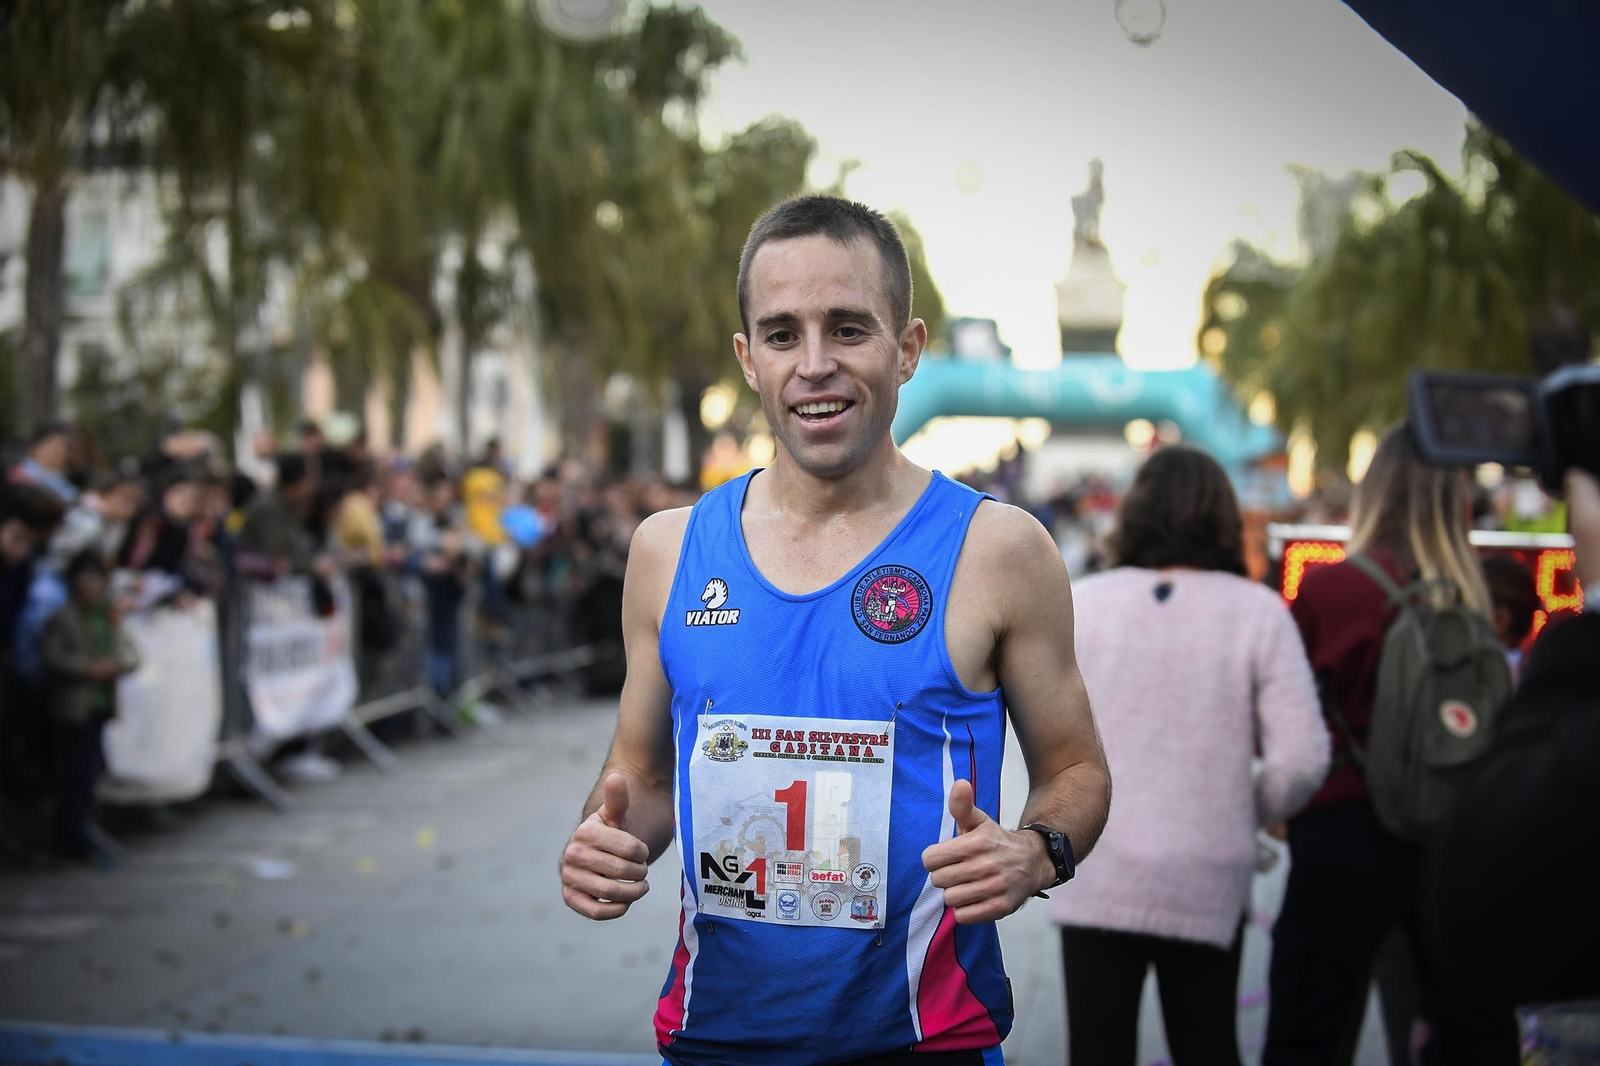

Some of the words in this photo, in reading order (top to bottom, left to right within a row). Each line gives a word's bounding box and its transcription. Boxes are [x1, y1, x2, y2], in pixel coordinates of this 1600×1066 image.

[865, 567, 906, 584] ATLETISMO
[856, 584, 866, 594] DE
[907, 572, 929, 604] CARMONA
[855, 597, 863, 618] CLUB
[916, 605, 929, 627] PAEZ
[686, 608, 740, 627] VIATOR
[860, 619, 874, 634] SAN
[874, 627, 916, 642] FERNANDO
[751, 728, 771, 740] III
[775, 729, 805, 742] SAN
[808, 731, 889, 746] SILVESTRE
[769, 741, 874, 757] GADITANA
[774, 780, 808, 851] 1
[812, 871, 844, 882] aefat
[704, 884, 745, 899] MERCHAN
